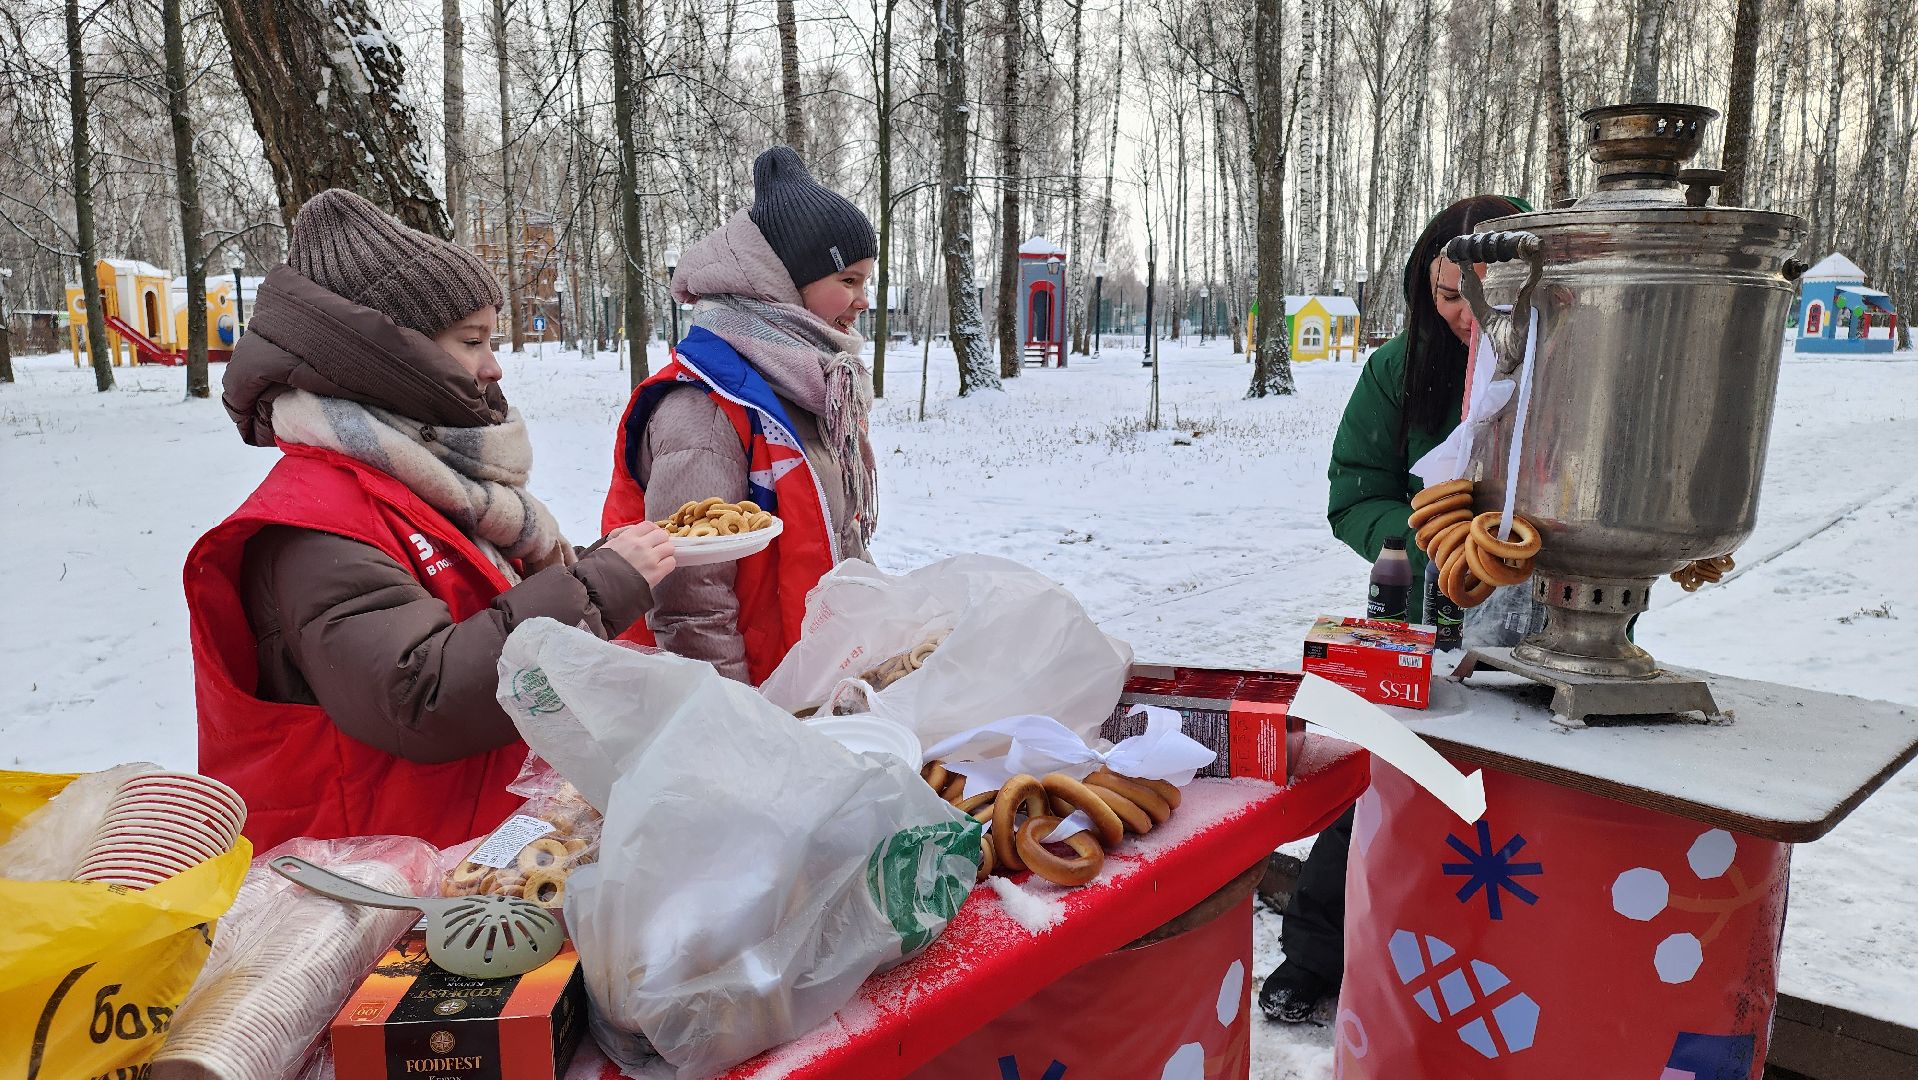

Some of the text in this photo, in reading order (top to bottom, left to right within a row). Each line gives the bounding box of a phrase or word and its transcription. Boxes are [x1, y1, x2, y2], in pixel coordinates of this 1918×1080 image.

[1378, 679, 1423, 704] TESS
[415, 987, 503, 999] FOODFEST
[357, 1008, 379, 1016] 100
[405, 1055, 483, 1073] FOODFEST
